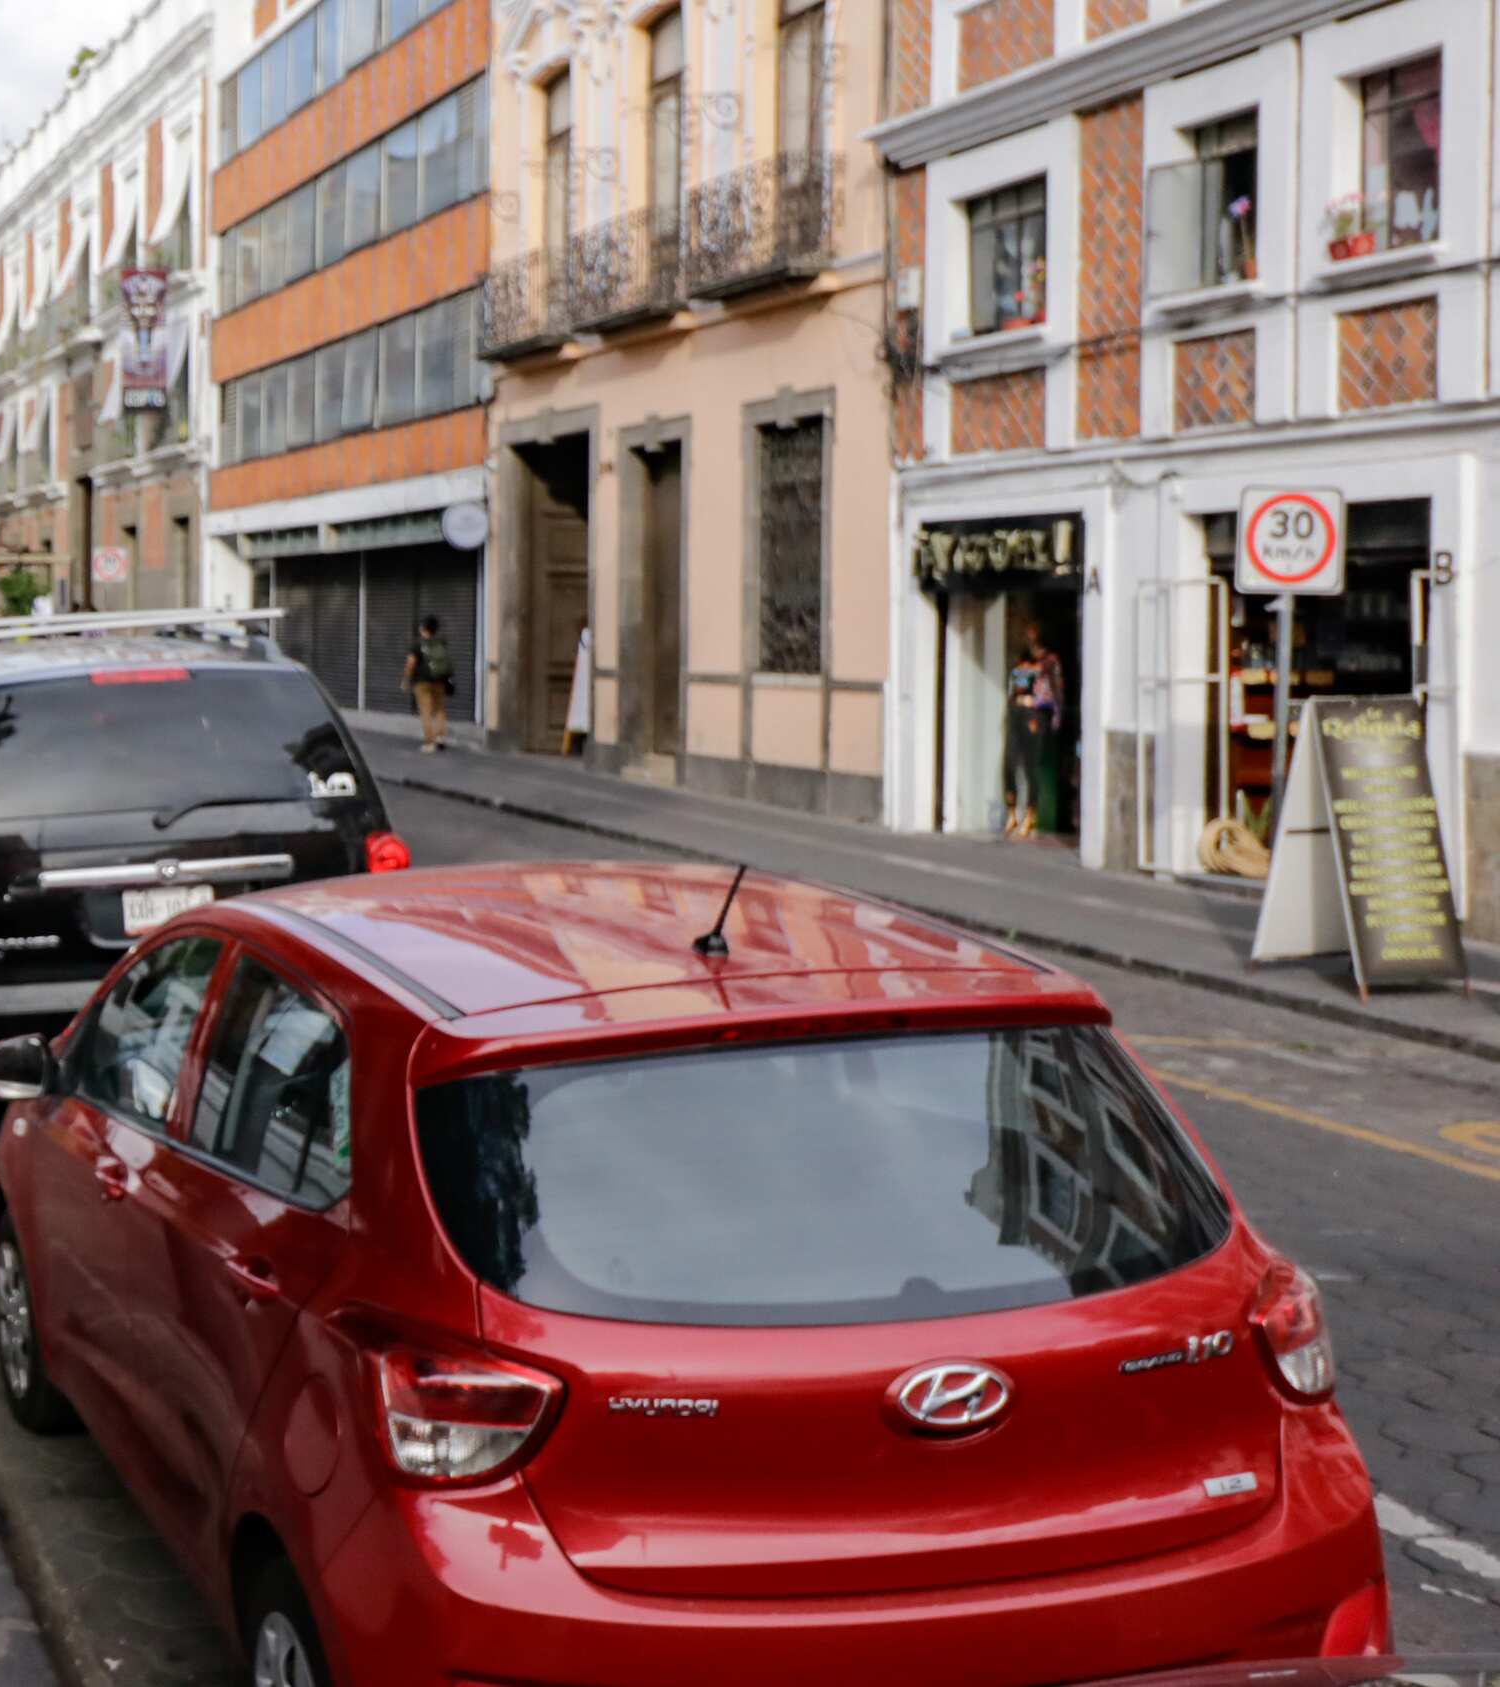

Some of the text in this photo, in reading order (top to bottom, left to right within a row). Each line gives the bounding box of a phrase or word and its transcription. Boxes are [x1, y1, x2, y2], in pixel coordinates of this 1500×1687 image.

[1269, 510, 1315, 539] 30
[1262, 545, 1316, 561] km/h
[1086, 566, 1101, 595] A
[1435, 551, 1454, 585] B
